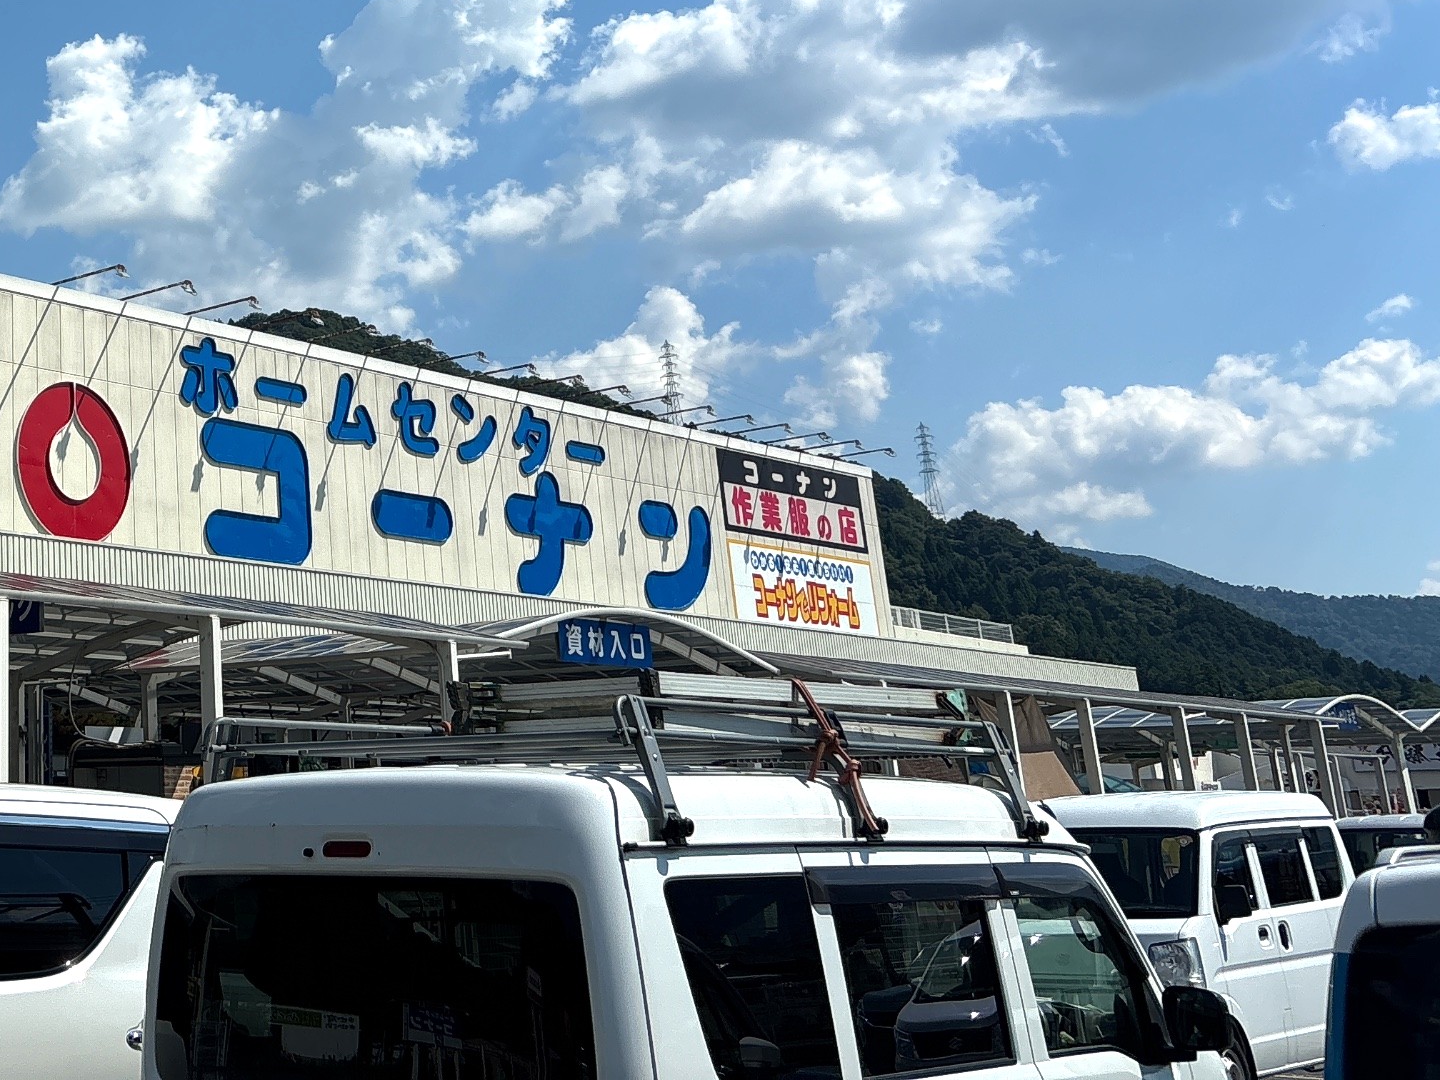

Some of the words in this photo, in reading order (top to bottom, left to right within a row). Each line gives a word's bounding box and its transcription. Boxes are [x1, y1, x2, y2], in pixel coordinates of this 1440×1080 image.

[180, 336, 606, 477] ホームセンター
[743, 460, 837, 499] コーナン
[201, 416, 712, 611] コーナン
[732, 486, 858, 544] 作業服の店
[752, 573, 861, 629] コーナンでリフォーム
[566, 624, 645, 659] 資材入口
